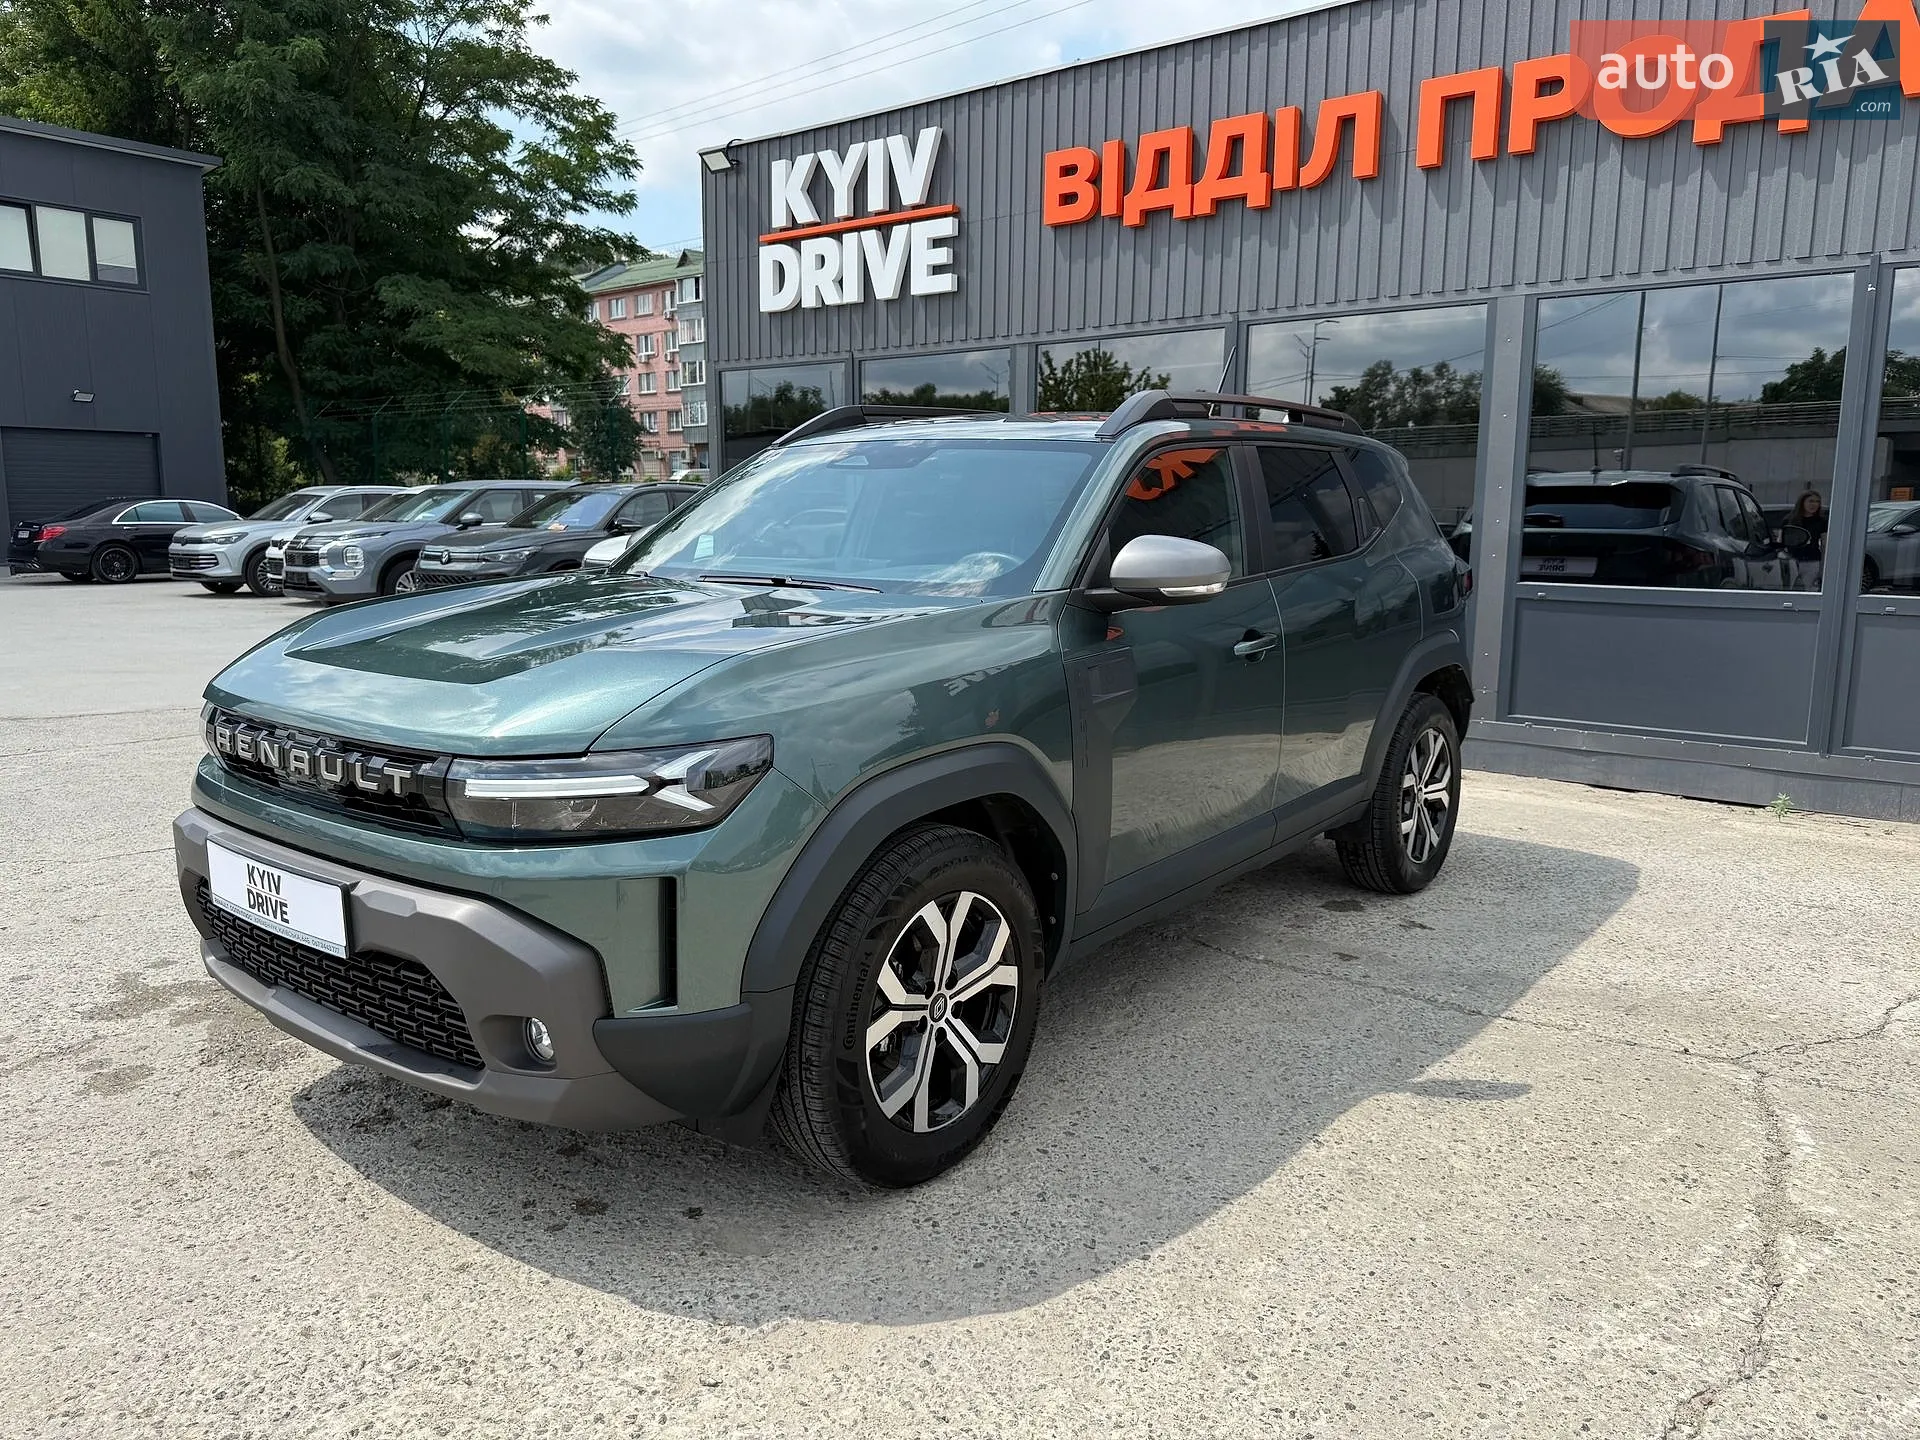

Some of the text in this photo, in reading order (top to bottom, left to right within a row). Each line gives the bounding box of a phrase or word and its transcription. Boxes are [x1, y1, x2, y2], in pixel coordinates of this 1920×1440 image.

[771, 126, 943, 230] KYIV
[1043, 89, 1383, 228] ВІДДІЛ
[759, 216, 959, 313] DRIVE
[215, 723, 413, 795] RENAULT
[247, 863, 281, 896] KYIV
[247, 888, 289, 924] DRIVE
